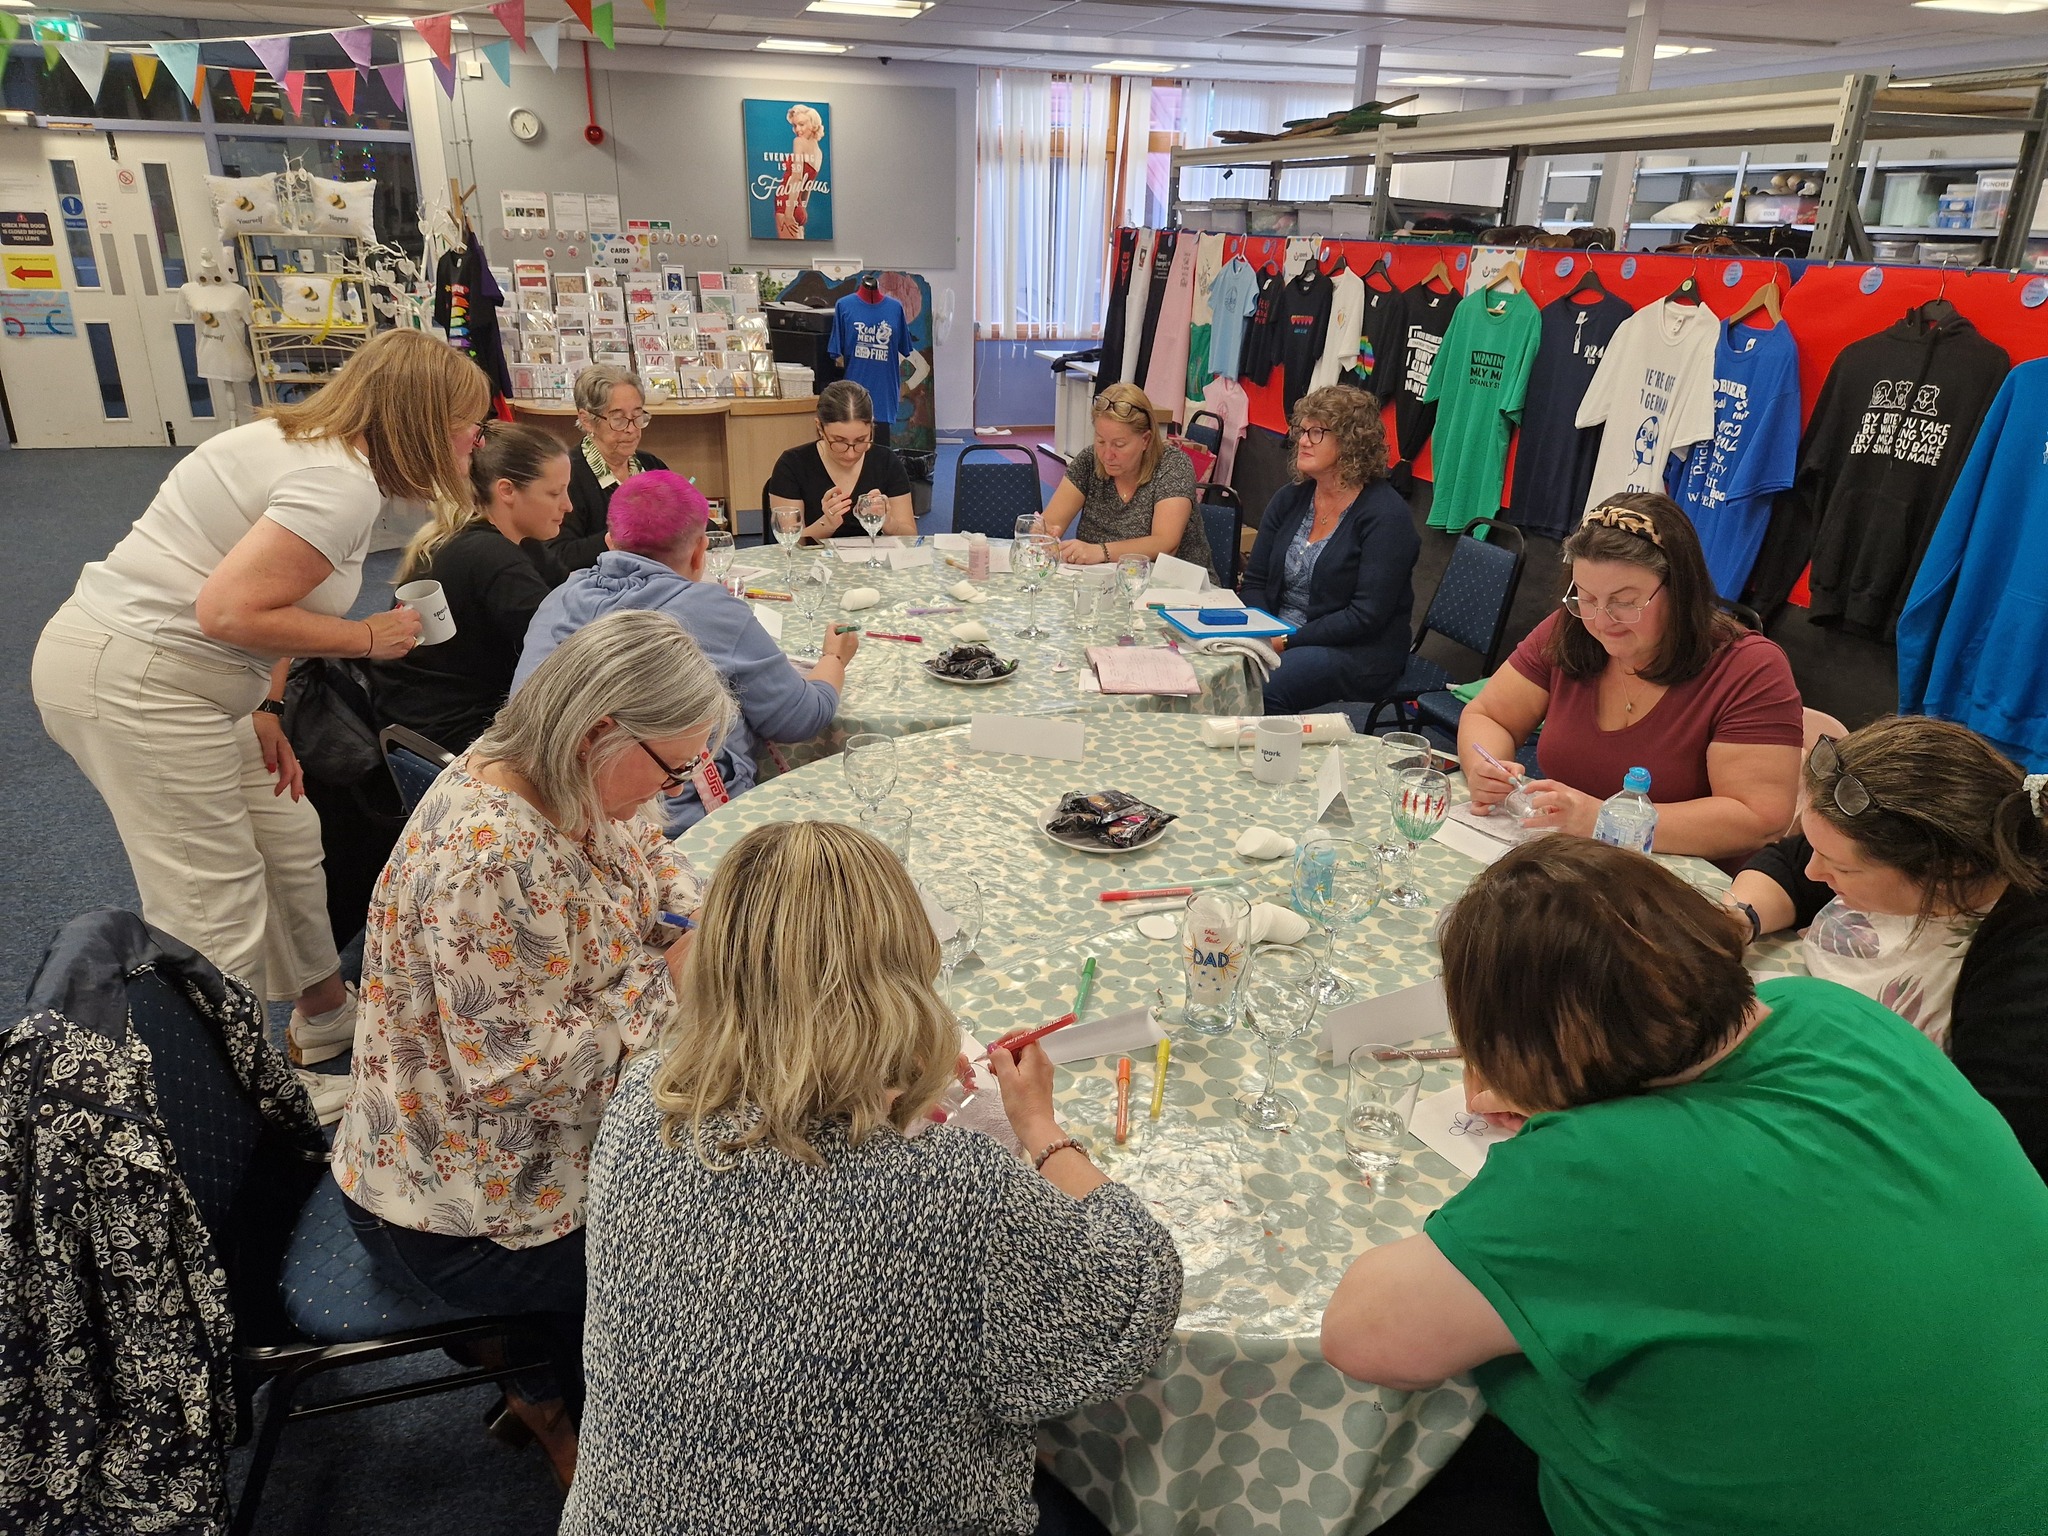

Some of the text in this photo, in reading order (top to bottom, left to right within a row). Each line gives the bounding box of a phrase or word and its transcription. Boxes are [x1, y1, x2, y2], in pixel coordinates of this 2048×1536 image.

[763, 151, 815, 163] EVERYTHING
[777, 162, 802, 172] IS SO
[750, 172, 830, 200] Fabulous
[776, 200, 807, 208] HERE
[853, 321, 876, 335] Real
[857, 334, 876, 342] MEN
[870, 348, 889, 361] FIRE
[1862, 424, 1877, 434] BE
[1921, 432, 1947, 446] YOU
[1920, 420, 1951, 436] TAKE
[1911, 441, 1944, 459] BAKE
[1907, 451, 1937, 466] MAKE
[1261, 748, 1281, 758] spark
[1193, 948, 1229, 968] DAD
